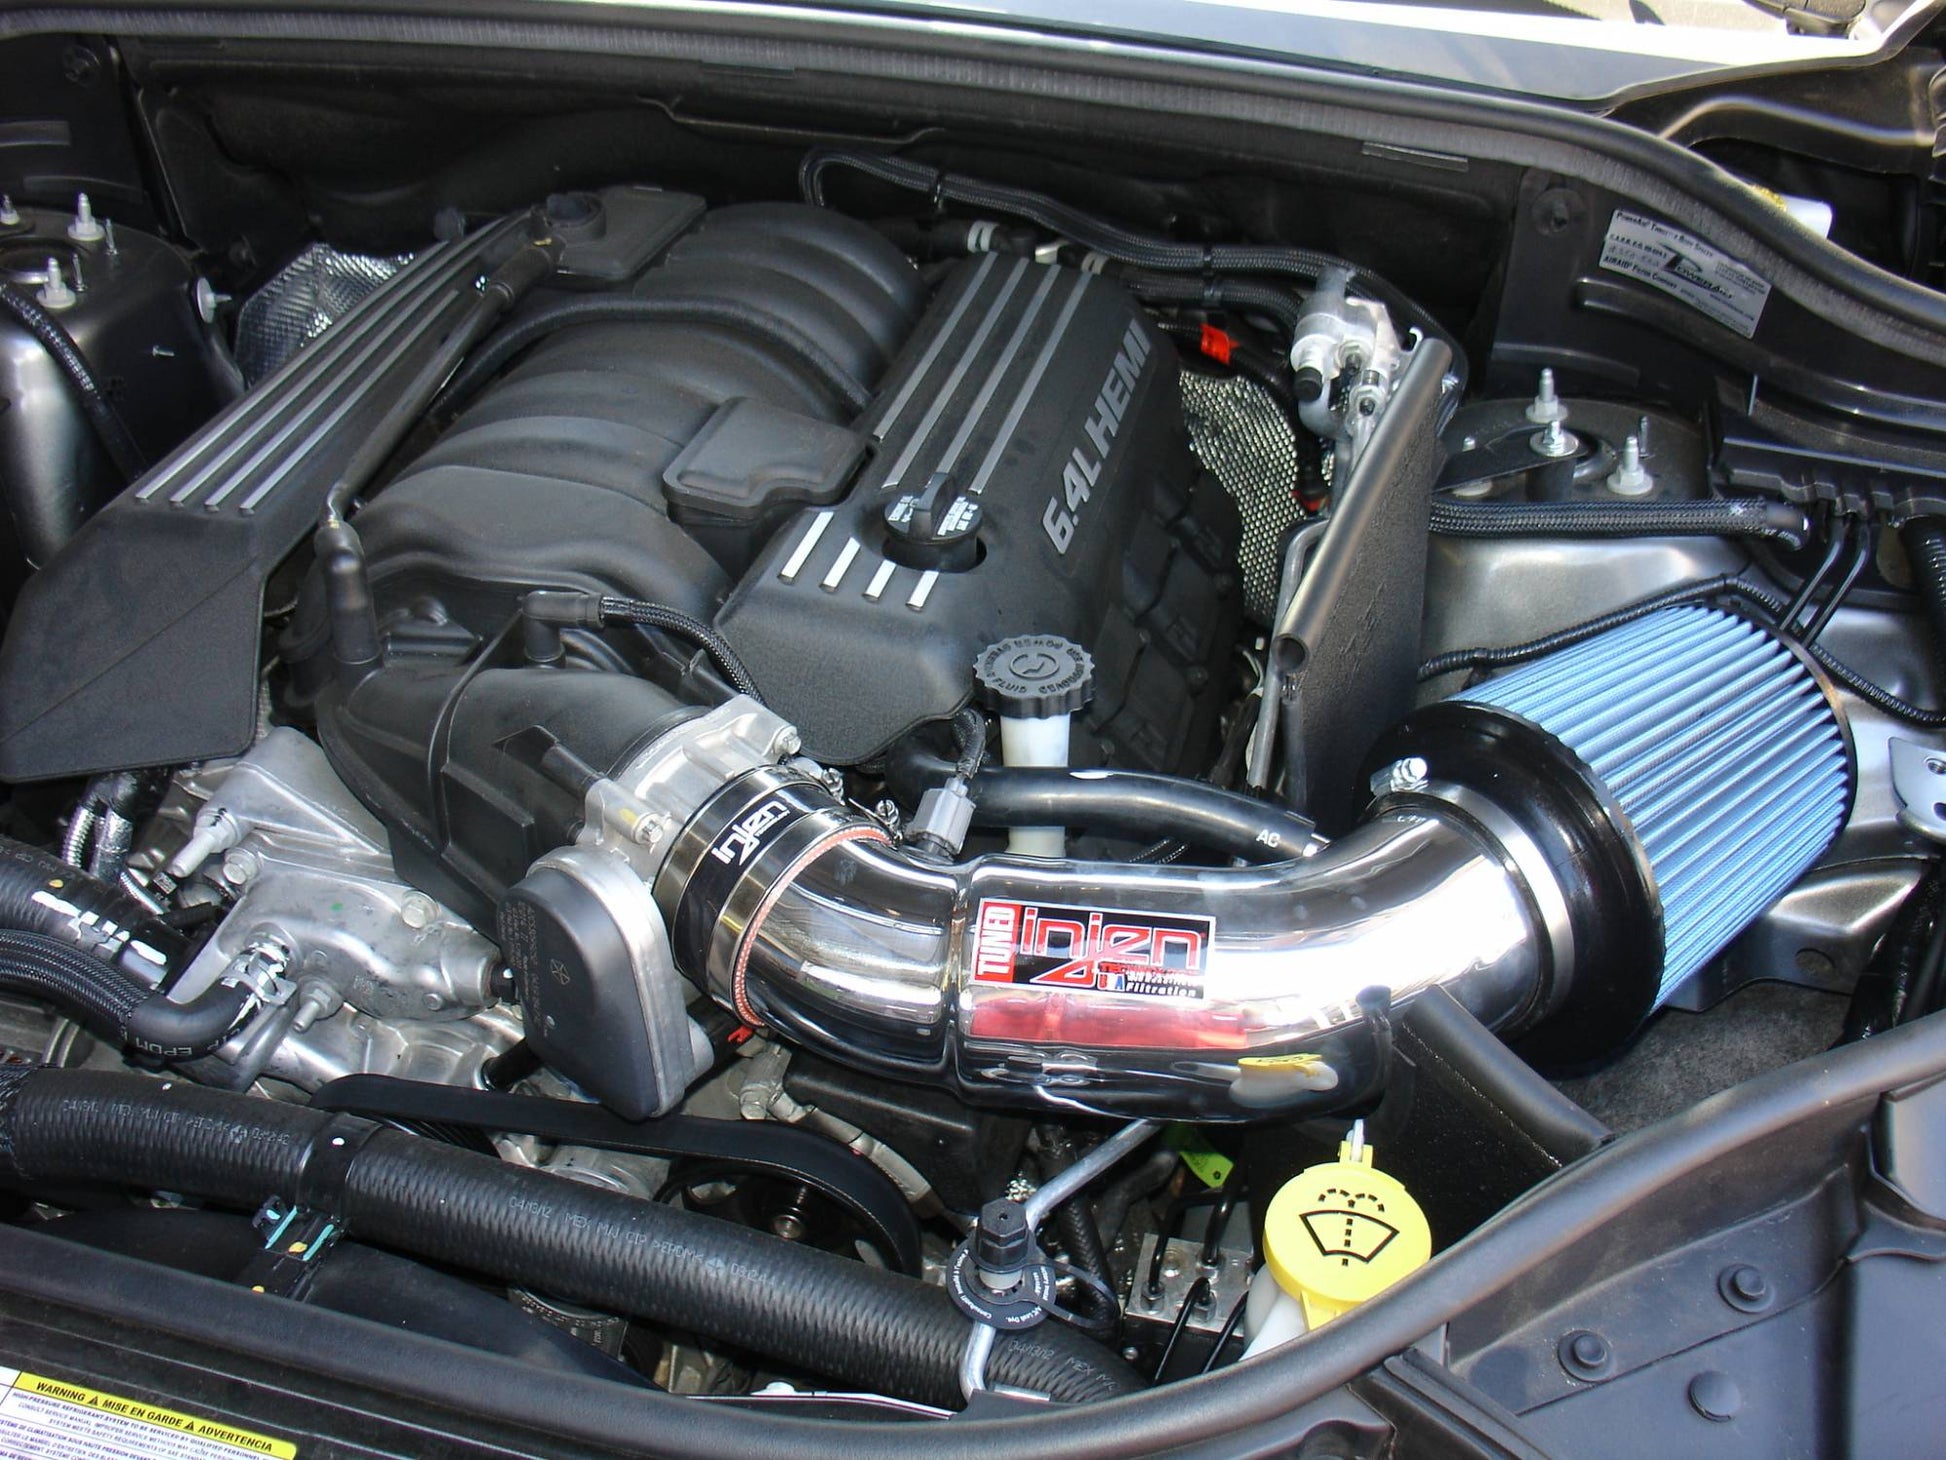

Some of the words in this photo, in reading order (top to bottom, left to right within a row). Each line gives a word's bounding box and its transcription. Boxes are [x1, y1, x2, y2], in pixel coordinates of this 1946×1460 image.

[1042, 447, 1102, 554] 6.4L
[1084, 318, 1151, 459] HEMI
[1255, 828, 1281, 848] AC
[979, 905, 1015, 975] TUNED
[1019, 907, 1202, 987] injen
[1098, 973, 1124, 991] UA
[135, 1037, 193, 1056] EPDM
[564, 1212, 591, 1229] MEX
[35, 1380, 86, 1402] WARNING
[101, 1398, 128, 1413] MISE
[129, 1405, 146, 1418] EN
[146, 1410, 183, 1427] GARDE
[198, 1424, 272, 1451] ADVERTENCIA
